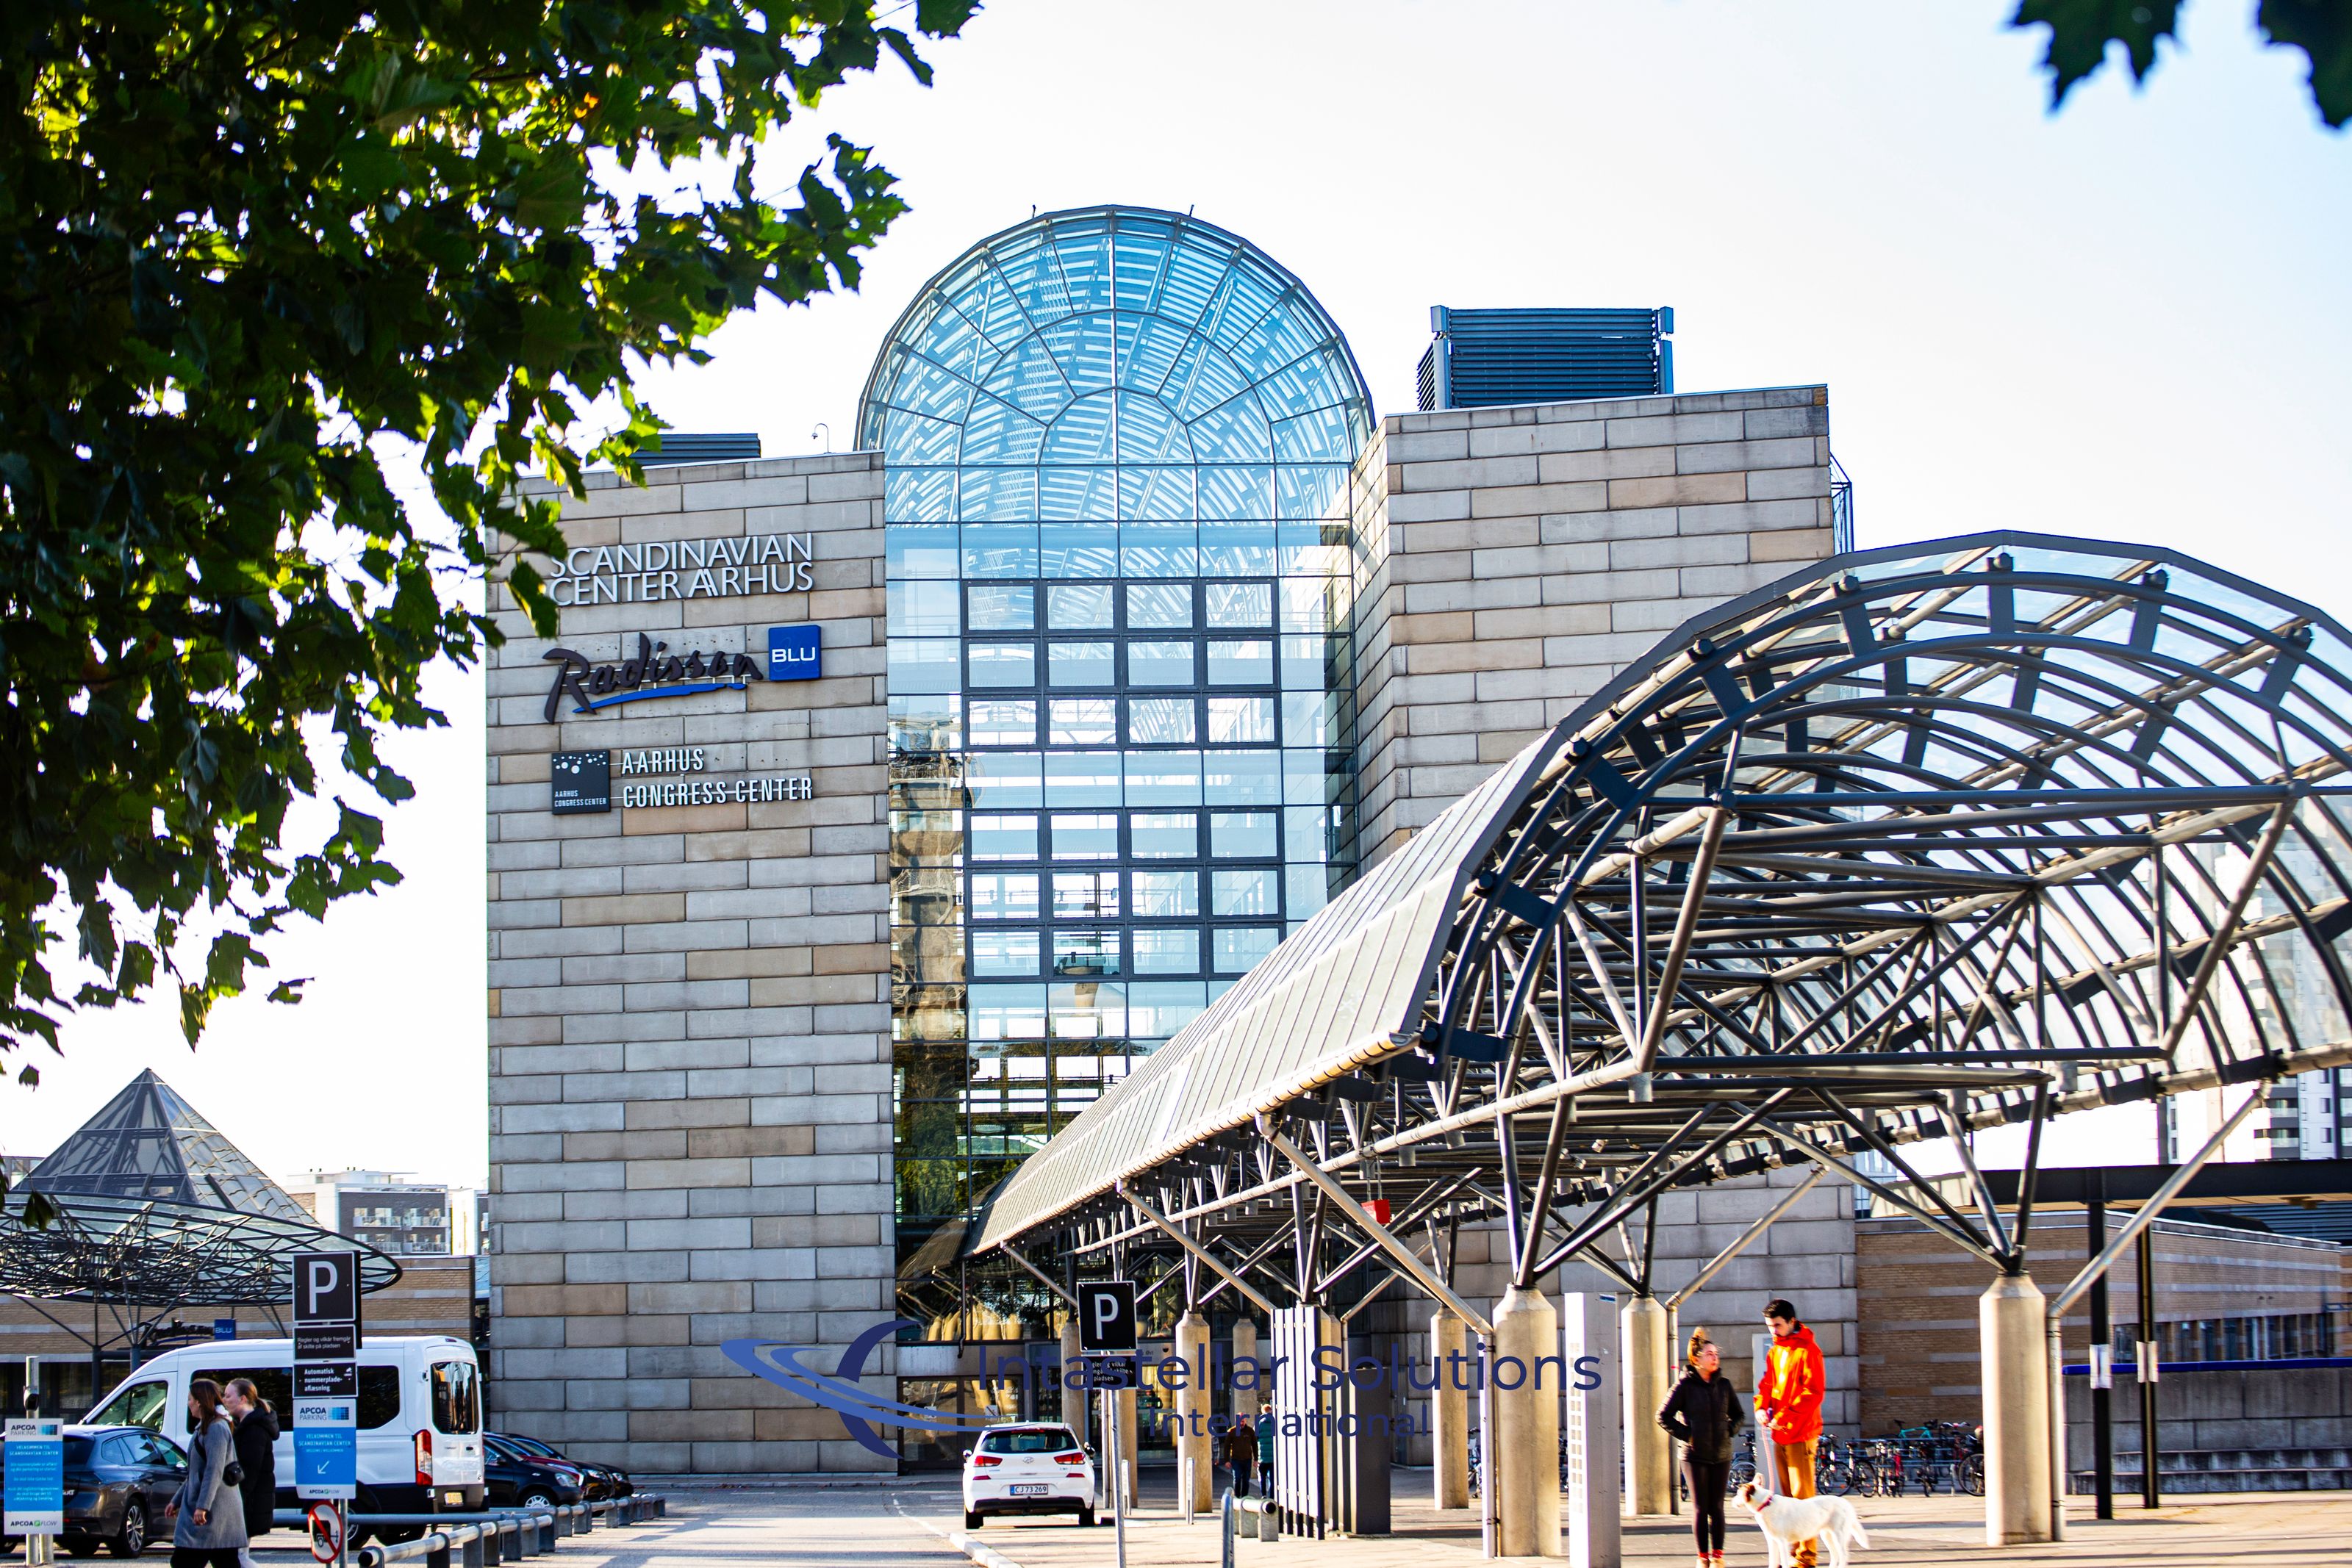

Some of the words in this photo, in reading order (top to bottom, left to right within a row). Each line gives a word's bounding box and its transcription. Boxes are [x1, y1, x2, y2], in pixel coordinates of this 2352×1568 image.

[550, 532, 813, 578] SCANDINAVIAN
[549, 570, 682, 606] CENTER
[542, 632, 763, 724] Radisson
[772, 647, 816, 663] BLU
[622, 748, 704, 774] AARHUS
[554, 790, 578, 798] AARHUS
[554, 799, 584, 807] CONGRESS
[584, 797, 607, 805] CENTER
[623, 781, 727, 808] CONGRESS
[736, 777, 813, 803] CENTER
[309, 1261, 337, 1314] P
[1094, 1294, 1119, 1339] P
